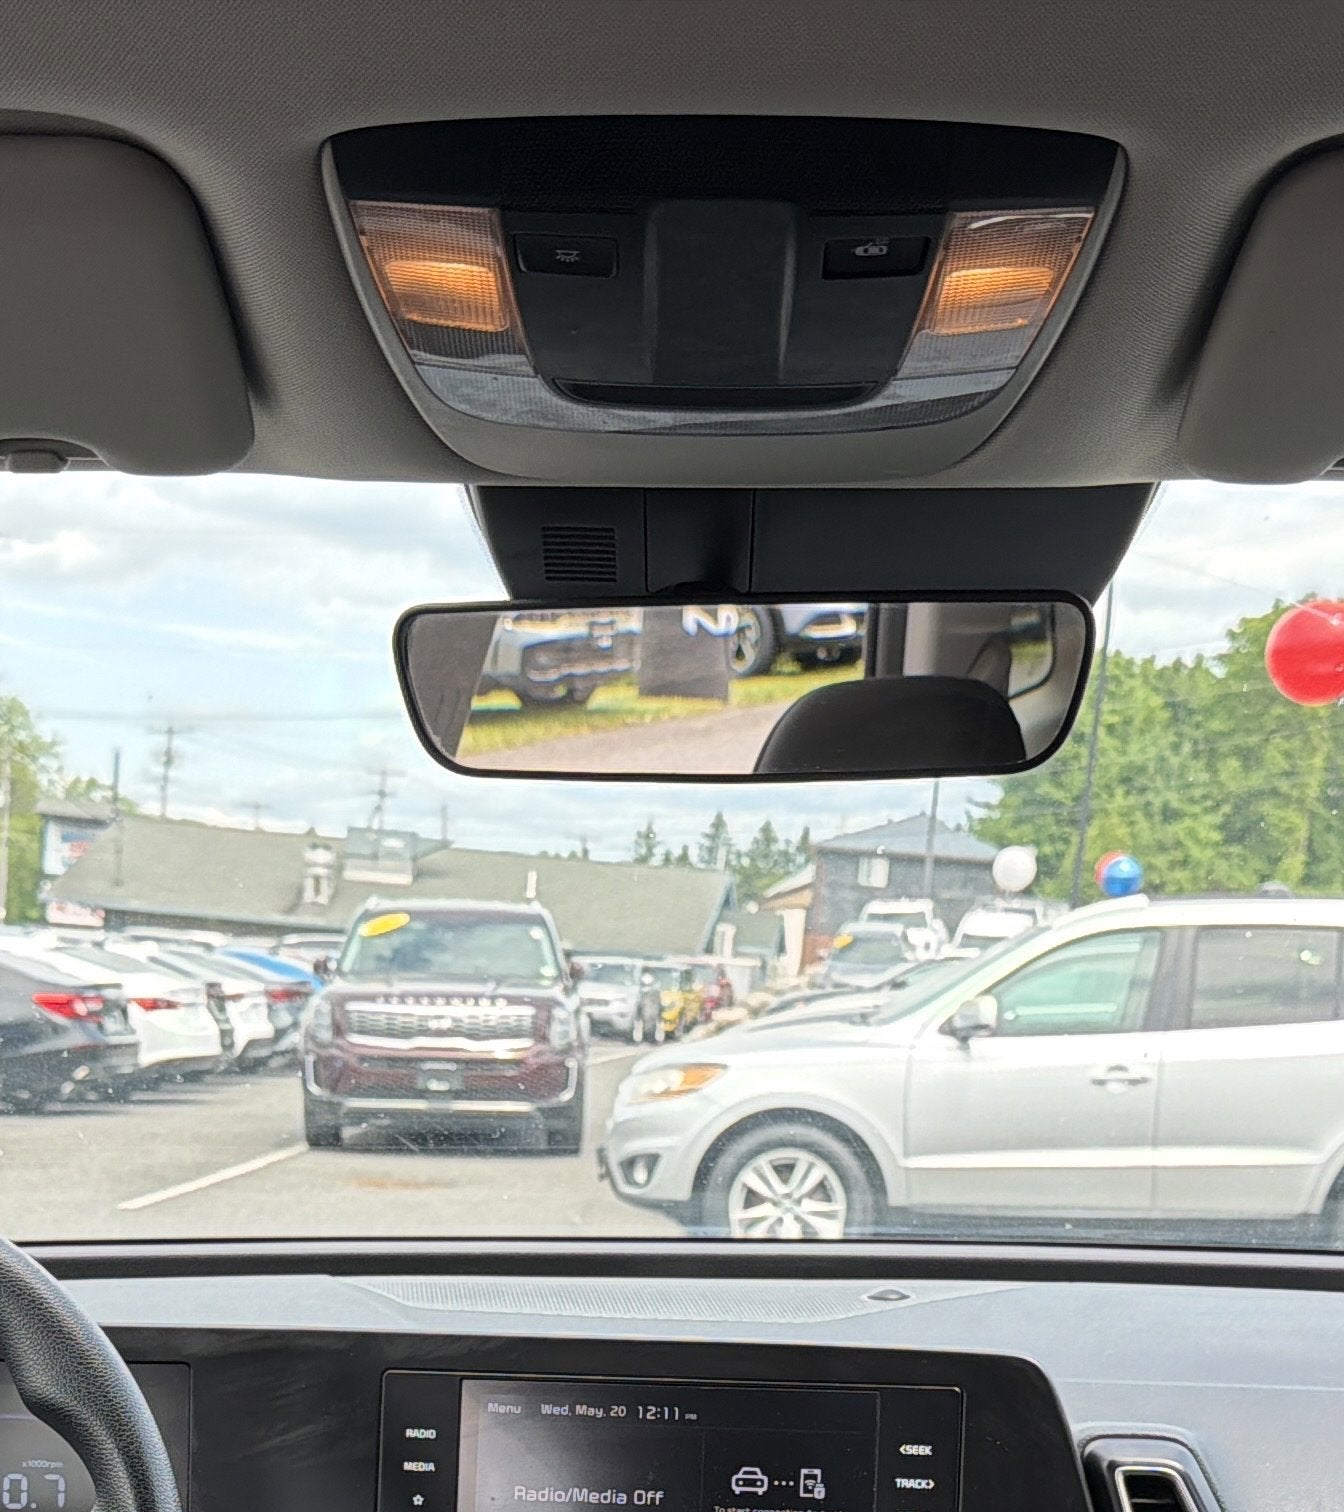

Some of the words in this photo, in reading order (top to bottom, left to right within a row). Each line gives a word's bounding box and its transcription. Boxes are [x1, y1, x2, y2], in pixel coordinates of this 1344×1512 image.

[487, 1402, 522, 1414] Menu
[610, 1406, 627, 1417] 20
[637, 1405, 680, 1421] 12:11
[406, 1429, 436, 1439] RADIO
[403, 1462, 435, 1472] MEDIA
[3, 1473, 66, 1510] 0.7
[514, 1485, 627, 1505] Radio/Media
[634, 1489, 664, 1505] Off
